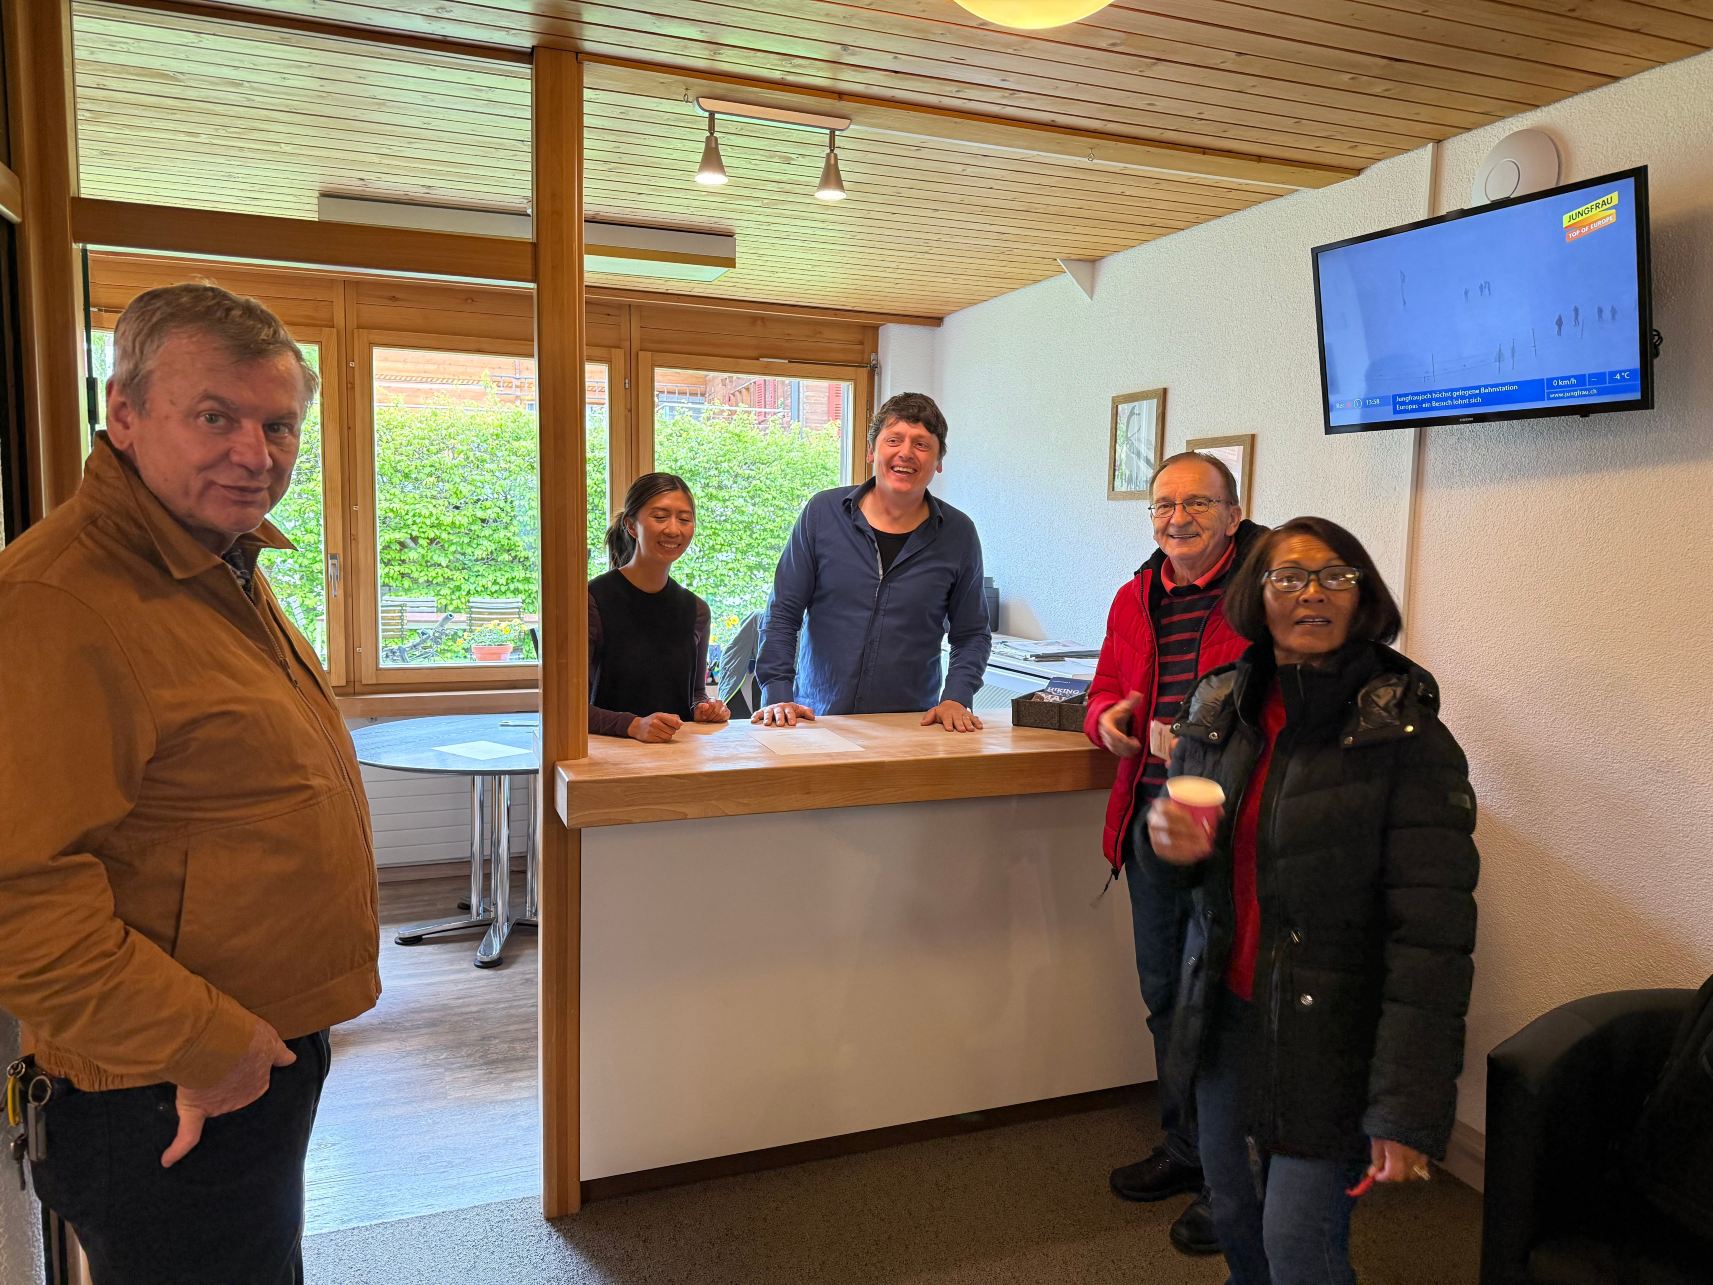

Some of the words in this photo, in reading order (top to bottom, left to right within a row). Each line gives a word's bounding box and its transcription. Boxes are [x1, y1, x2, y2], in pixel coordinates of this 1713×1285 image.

[1568, 196, 1613, 222] JUNGFRAU
[1569, 230, 1580, 238] TOP
[1581, 225, 1590, 233] OF
[1590, 215, 1613, 229] EUROPE
